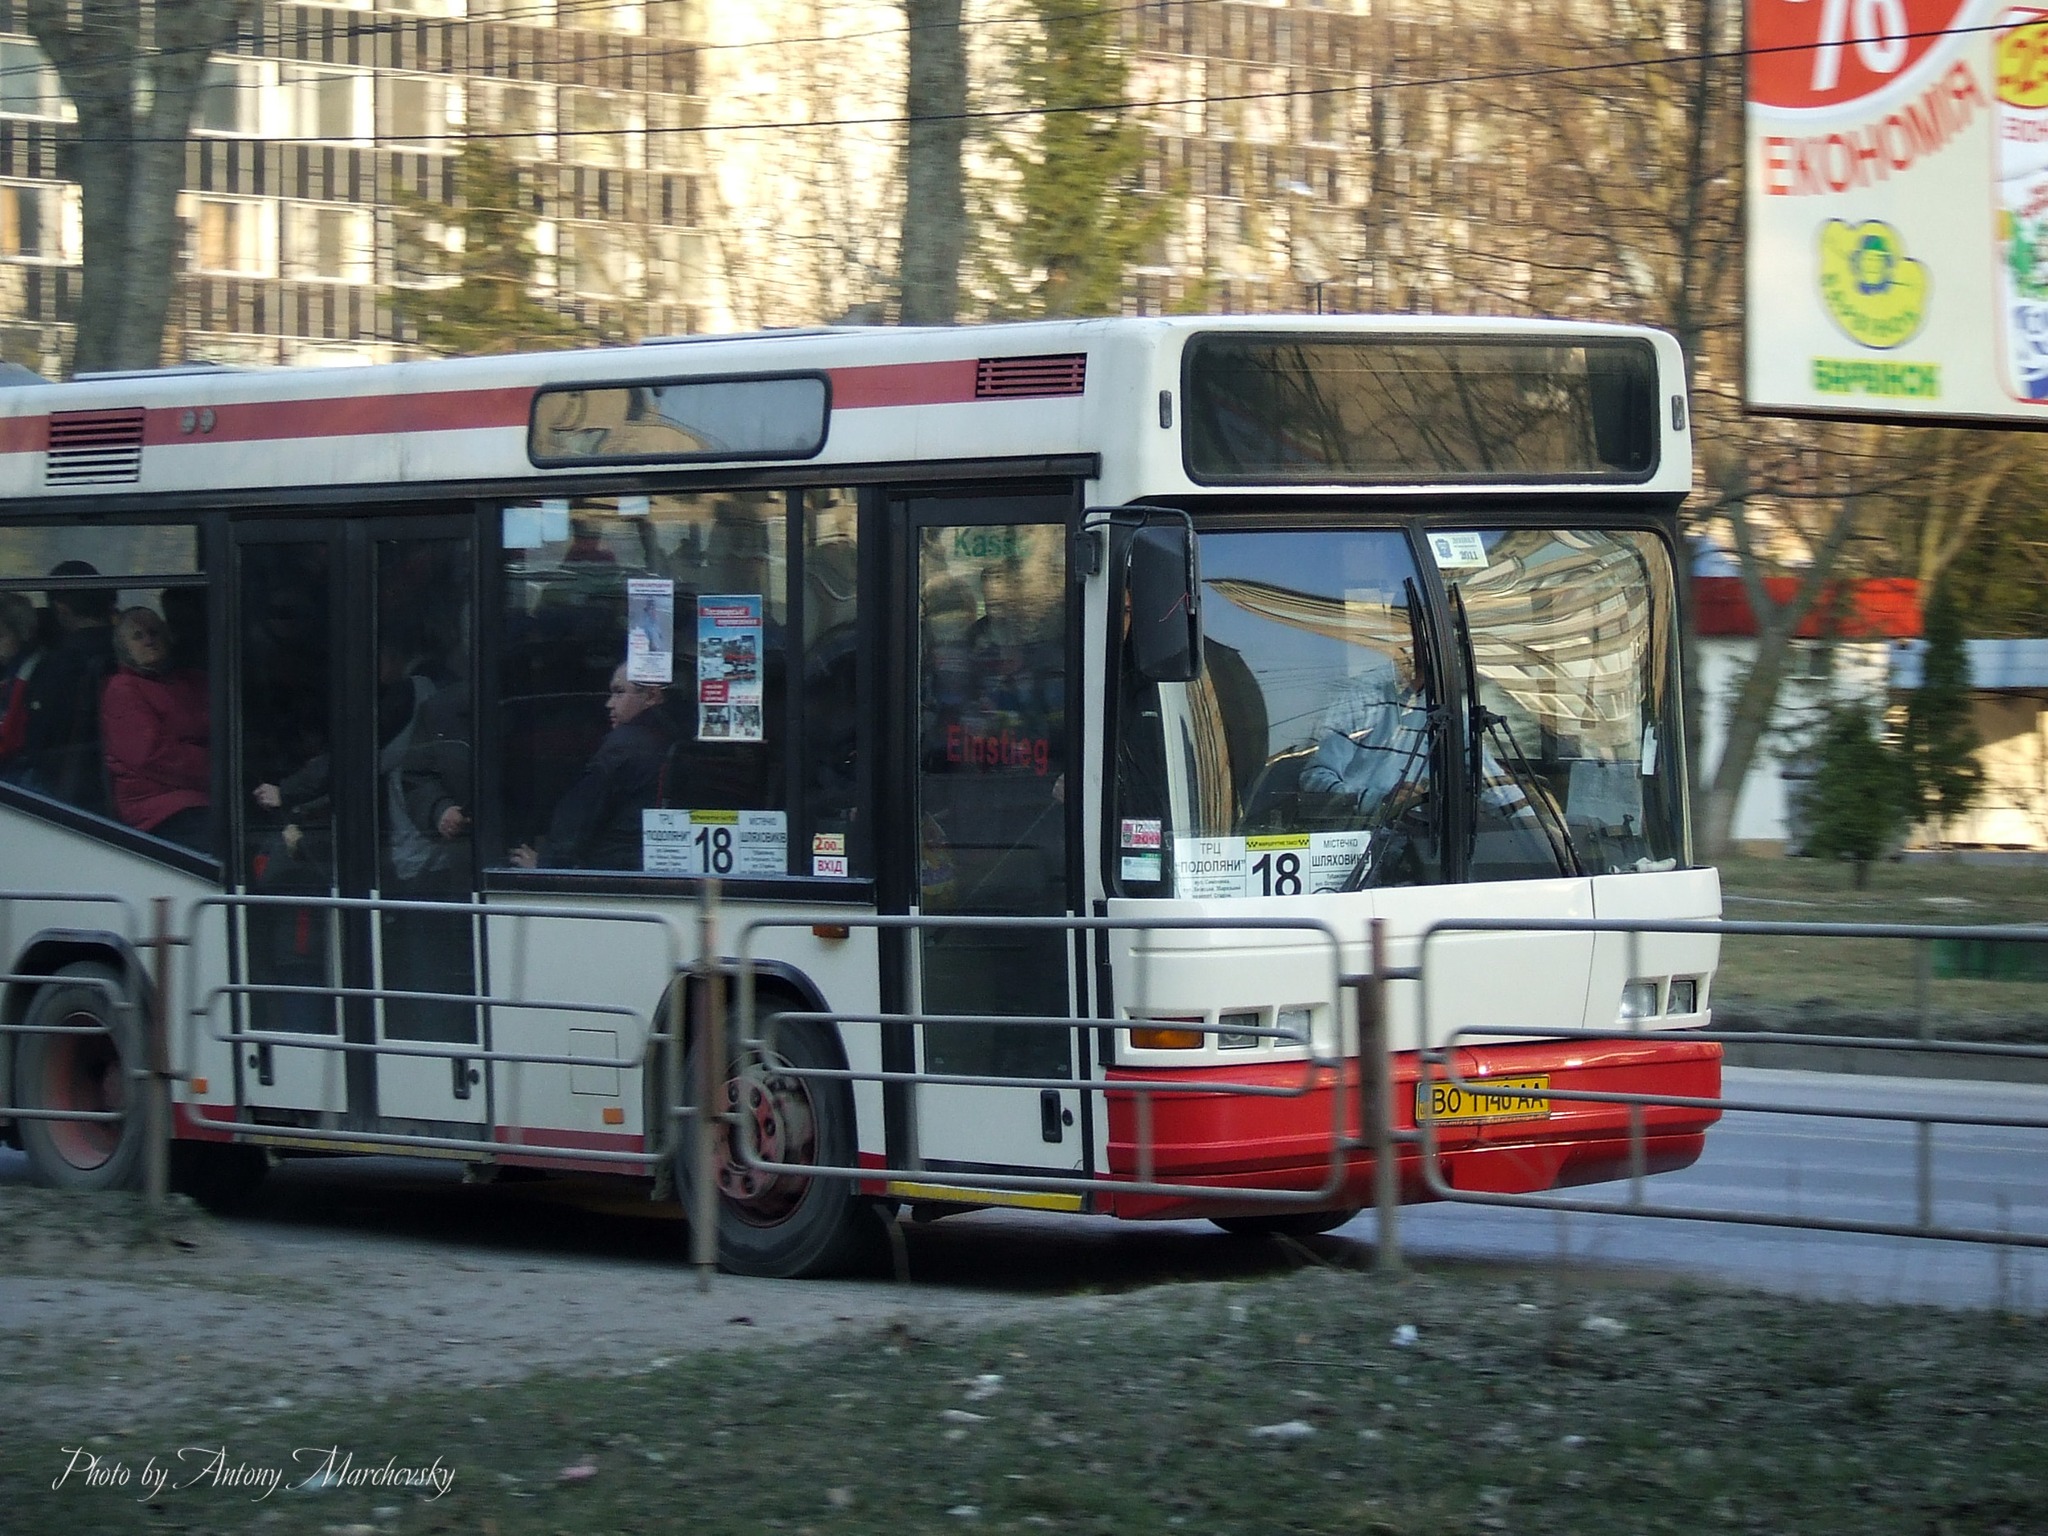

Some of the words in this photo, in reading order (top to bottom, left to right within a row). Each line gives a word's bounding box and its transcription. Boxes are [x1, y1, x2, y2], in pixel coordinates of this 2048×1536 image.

[695, 826, 733, 874] 18
[1200, 842, 1221, 856] ТРЦ
[817, 860, 843, 874] ВХІД
[1252, 852, 1301, 896] 18
